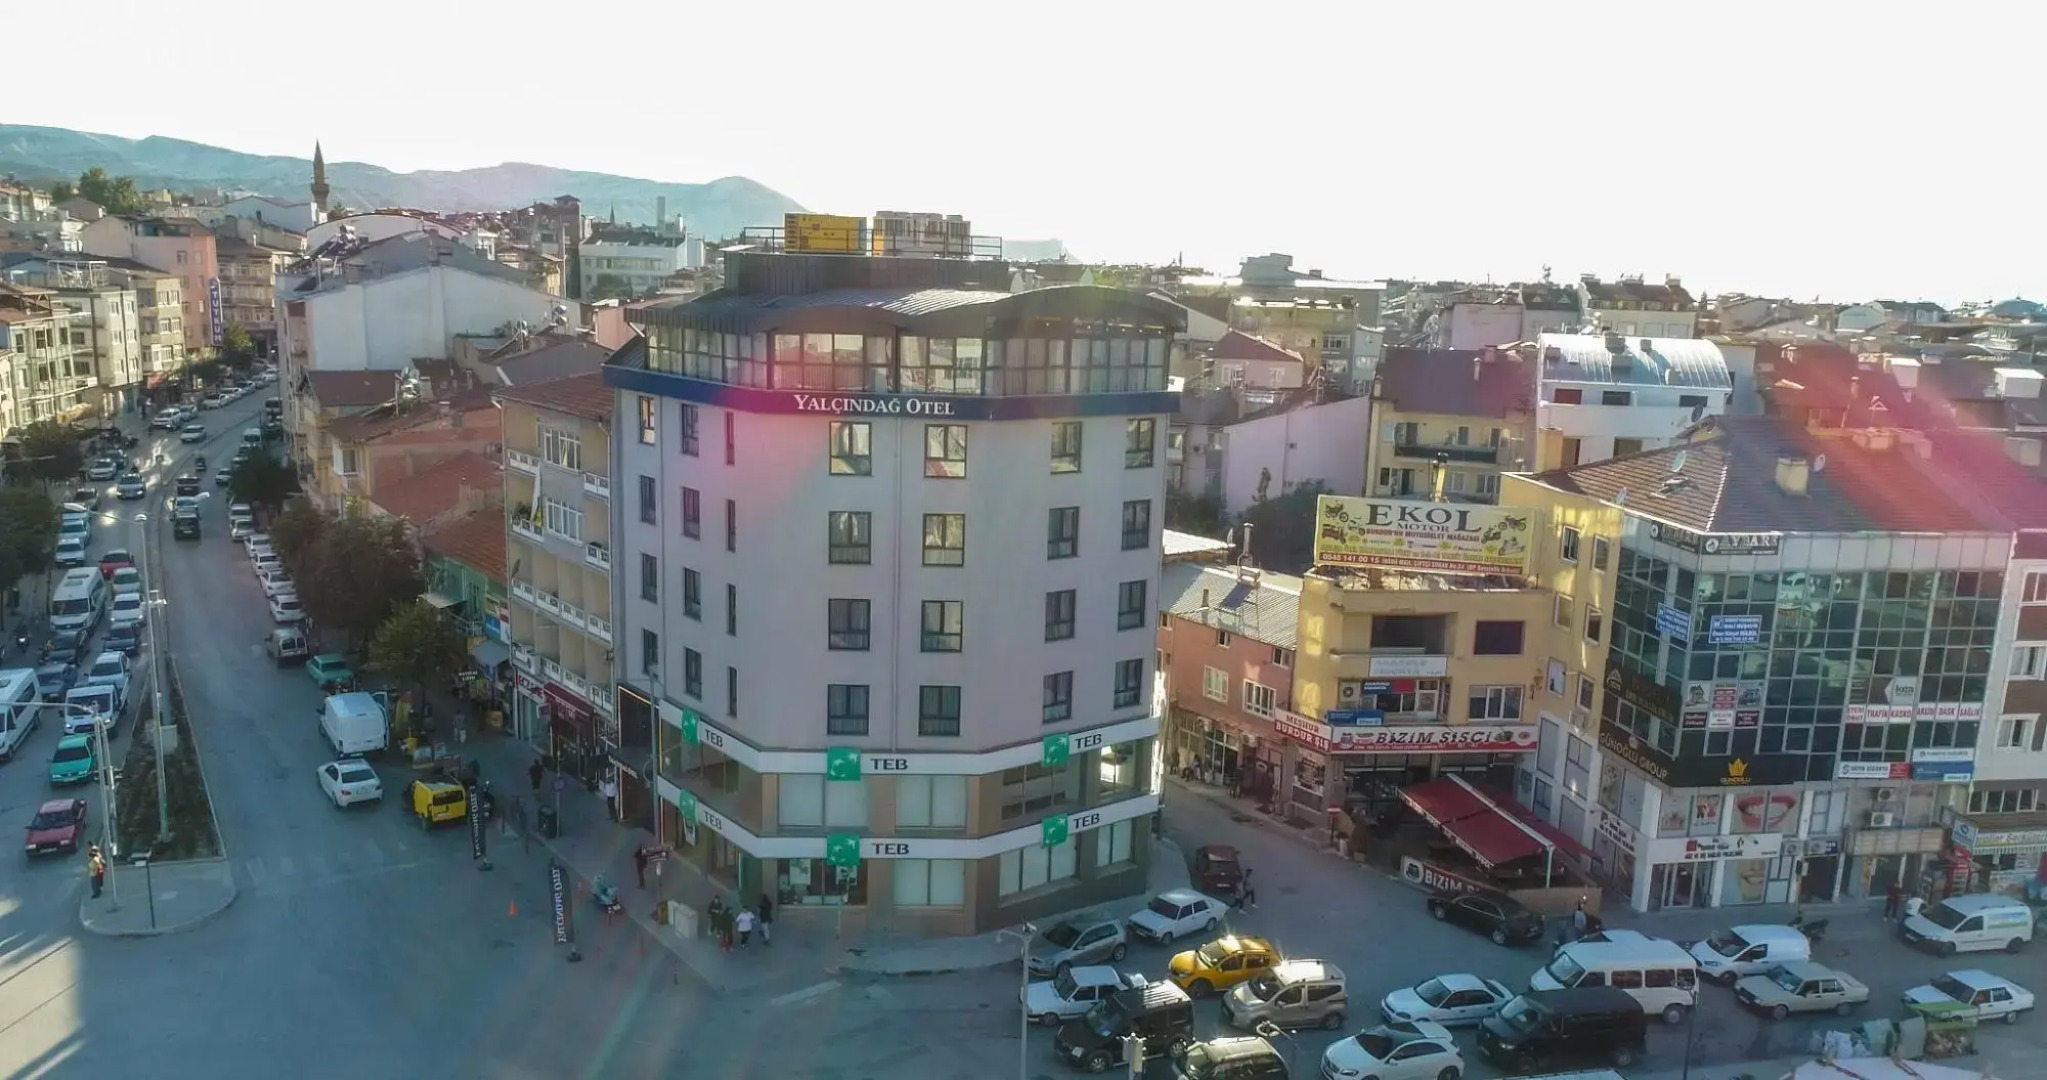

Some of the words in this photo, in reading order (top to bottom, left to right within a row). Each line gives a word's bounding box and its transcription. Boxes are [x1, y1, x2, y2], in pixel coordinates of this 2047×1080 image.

[794, 394, 900, 414] YALÇINDAĞ
[906, 398, 955, 415] OTEL
[1365, 504, 1481, 532] EKOL
[1397, 523, 1449, 532] MOTOR
[1447, 533, 1480, 541] MAĞAZASI
[704, 729, 723, 748] TEB
[1074, 733, 1103, 749] TEB
[1276, 721, 1312, 743] BURDUR
[870, 758, 908, 771] TEB
[703, 810, 722, 830] TEB
[1073, 812, 1100, 830] TEB
[871, 842, 910, 855] TEB
[1424, 869, 1462, 892] BİZİM
